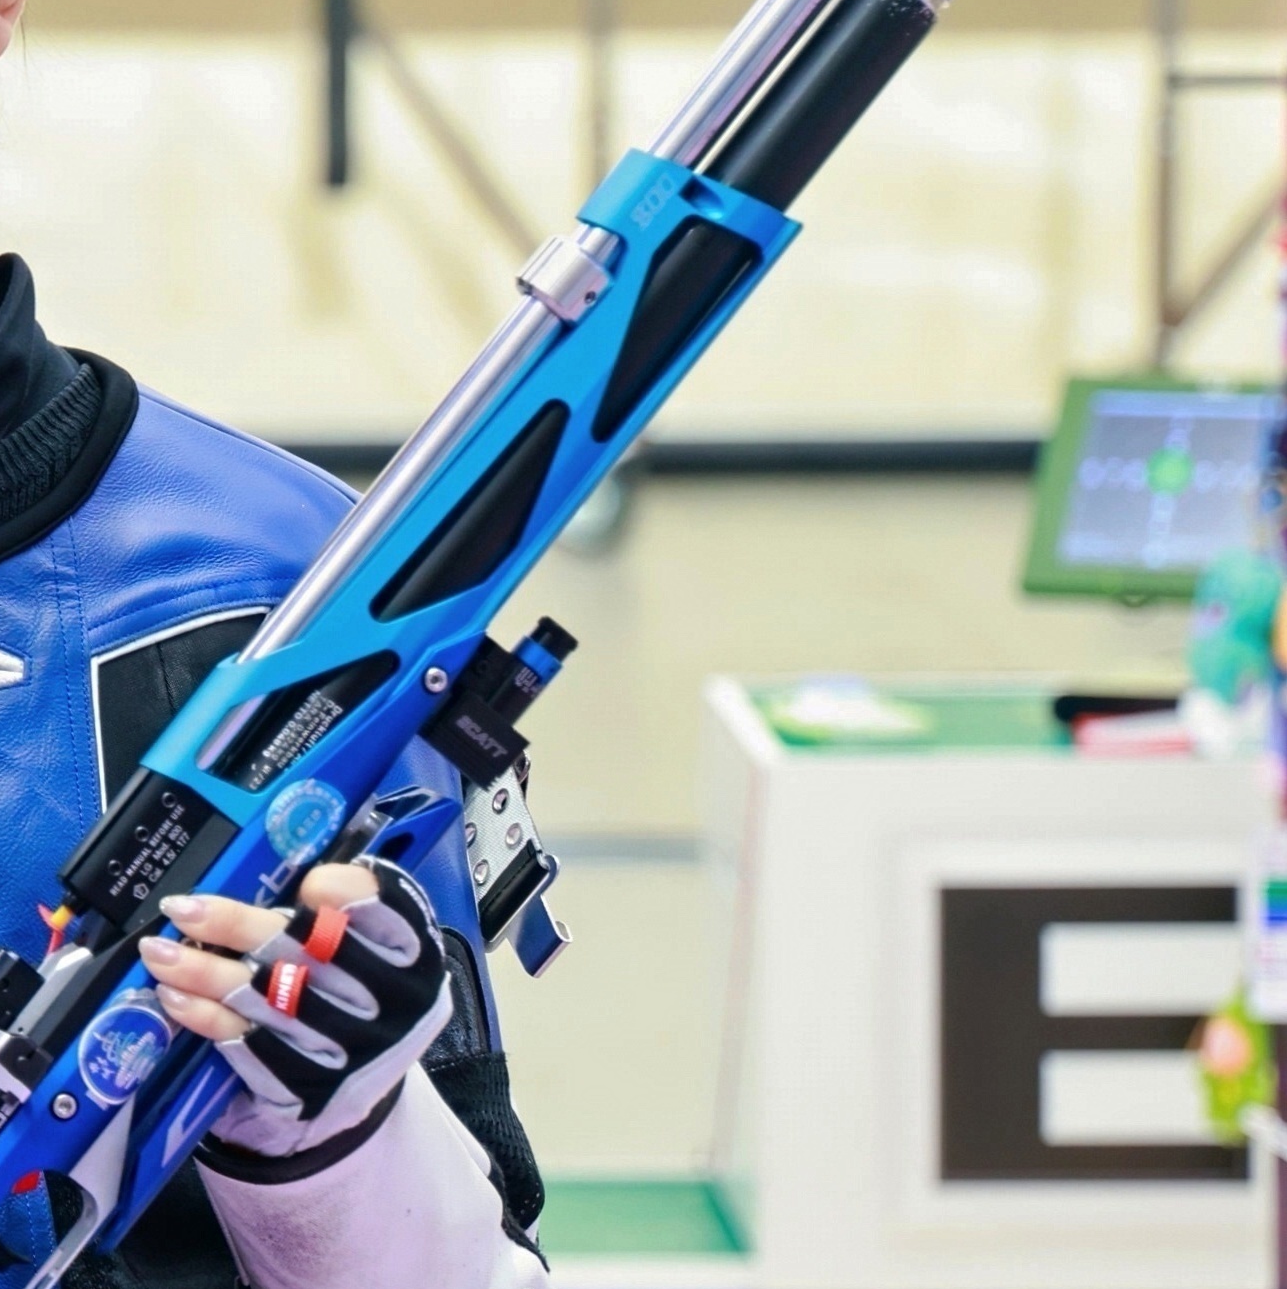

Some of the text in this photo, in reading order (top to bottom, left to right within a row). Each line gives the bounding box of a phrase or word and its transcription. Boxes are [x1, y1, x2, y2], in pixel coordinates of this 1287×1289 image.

[293, 688, 321, 721] NETTO
[454, 713, 509, 760] SCATT
[109, 804, 186, 897] READ MANUAL BEFORE USE
[139, 861, 154, 877] LG
[941, 888, 1249, 1181] E
